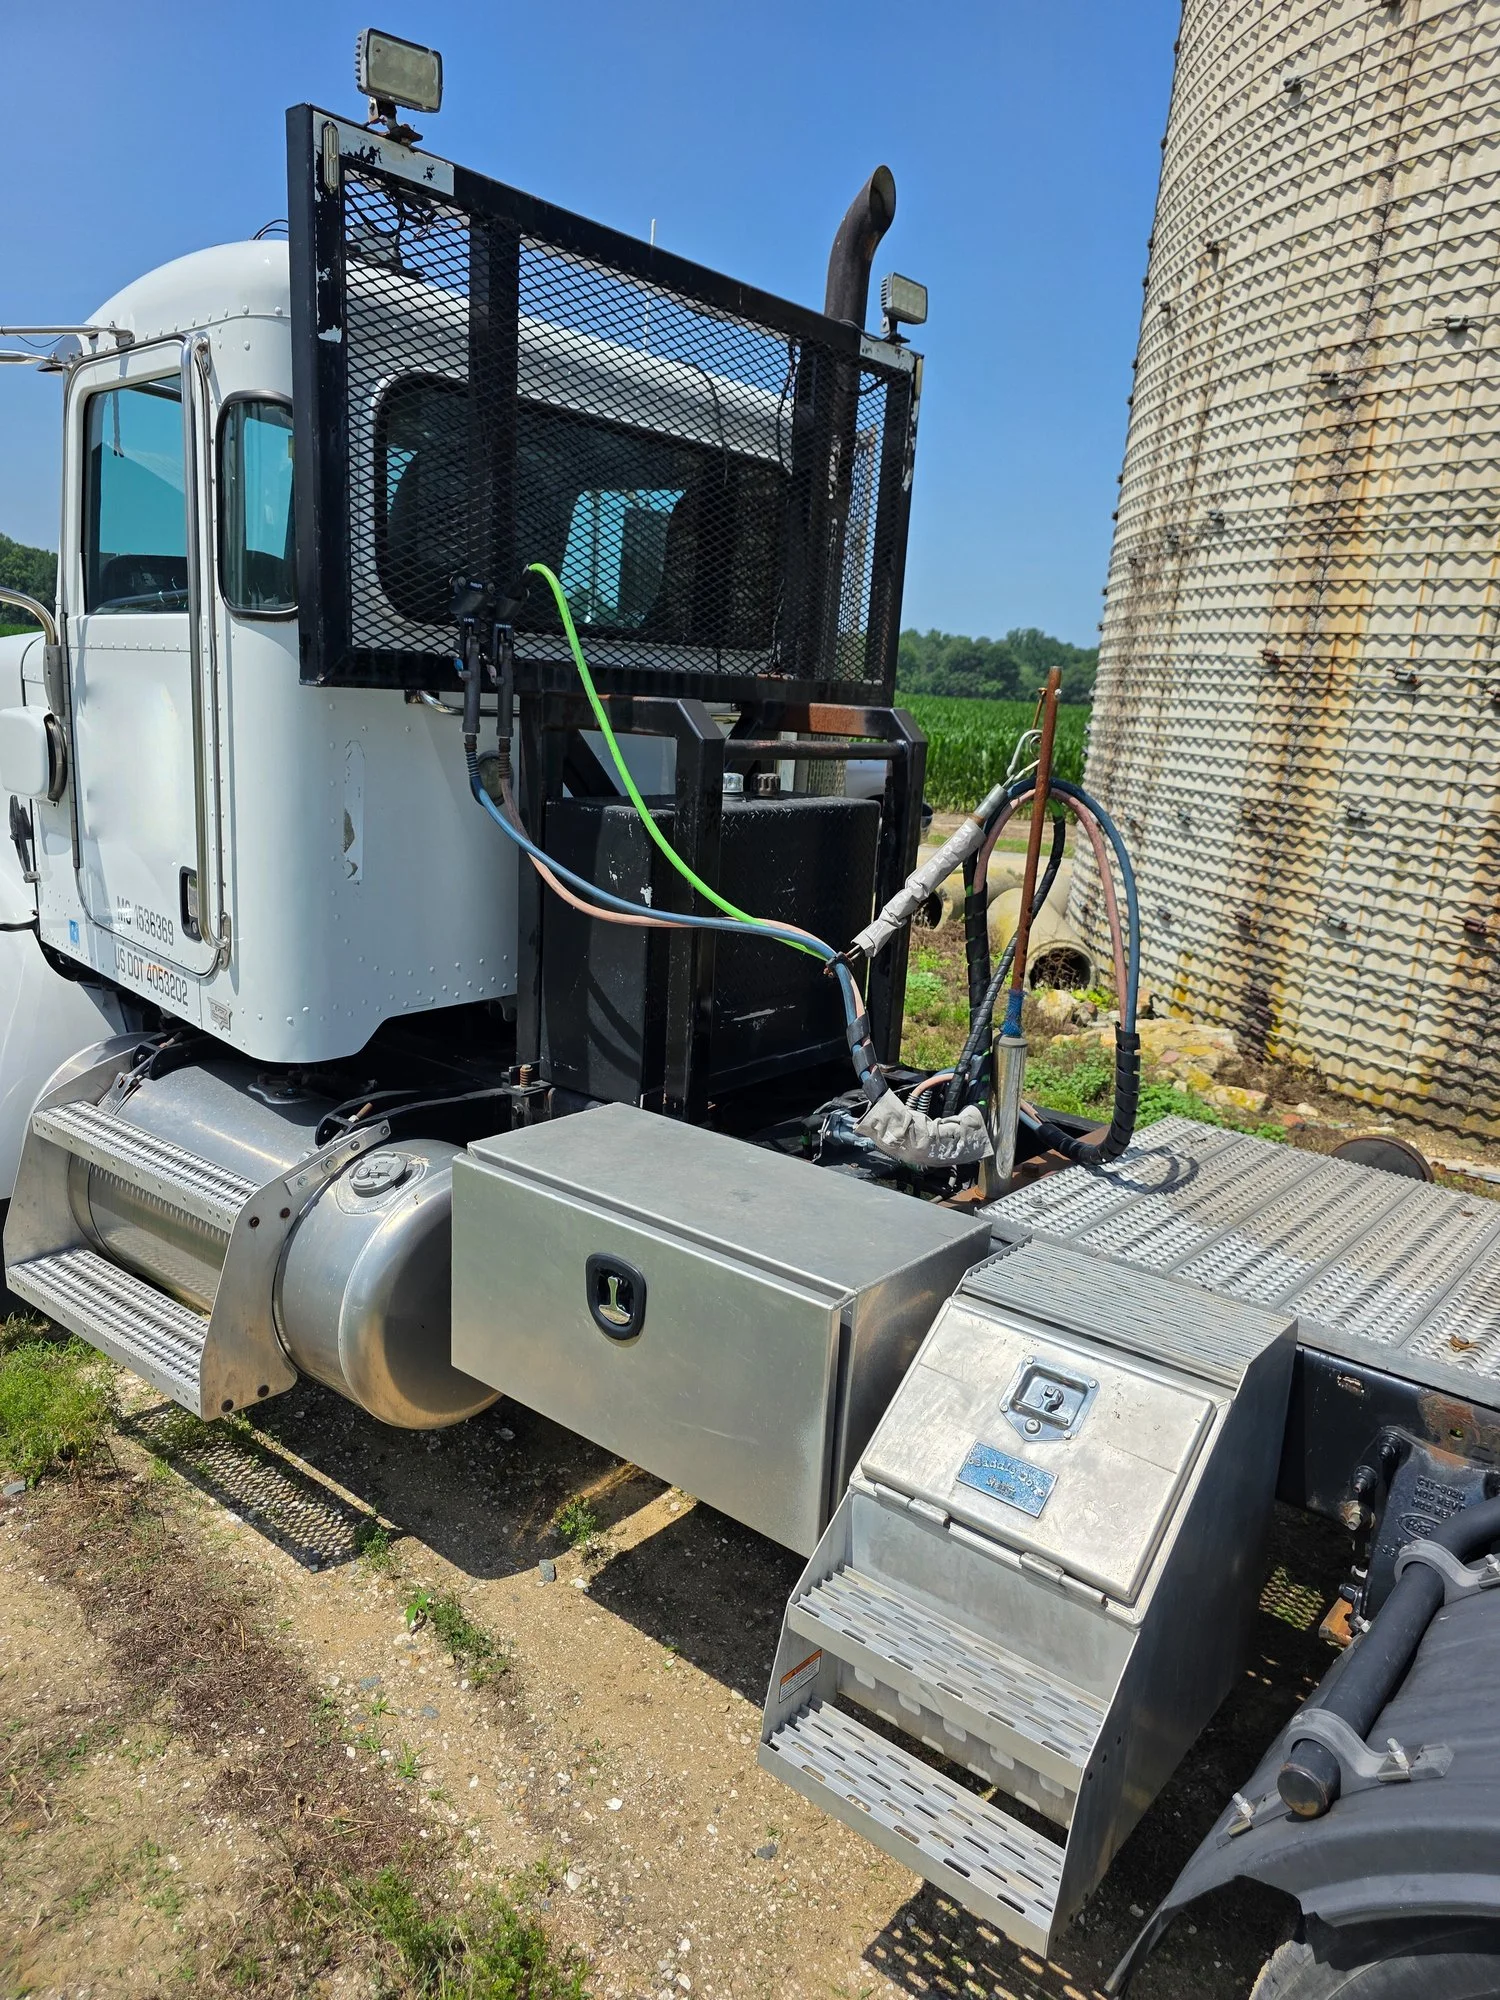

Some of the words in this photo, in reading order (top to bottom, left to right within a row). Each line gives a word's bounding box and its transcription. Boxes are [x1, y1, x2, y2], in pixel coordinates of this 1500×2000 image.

[134, 904, 174, 947] 1536369
[114, 944, 126, 973] US
[127, 951, 144, 984] DOT
[146, 962, 189, 1007] 4053202
